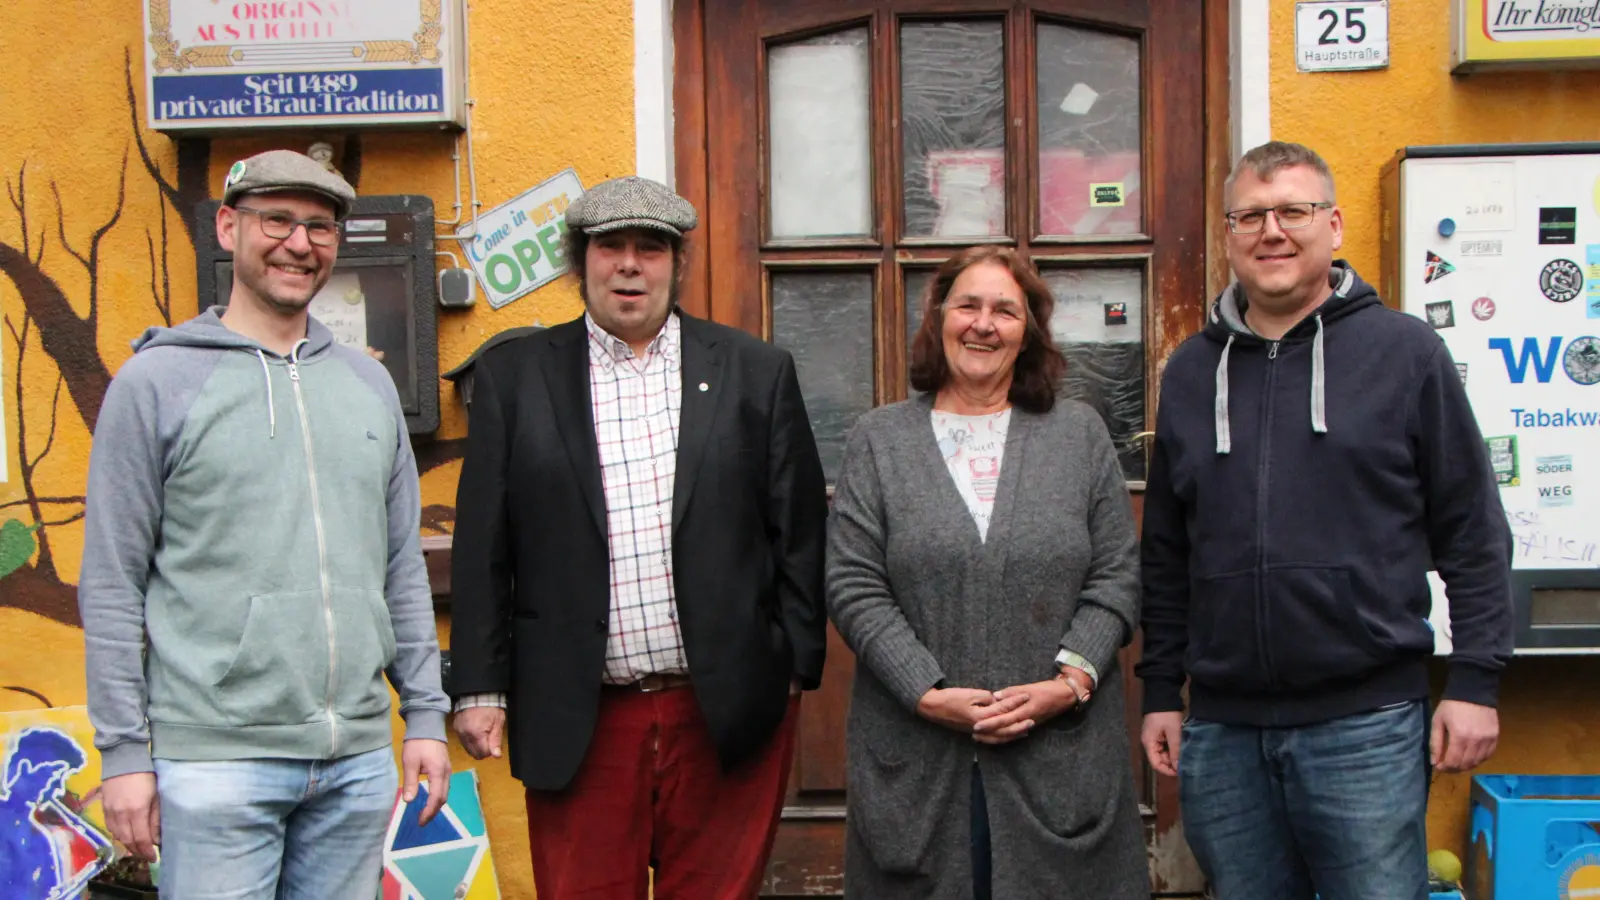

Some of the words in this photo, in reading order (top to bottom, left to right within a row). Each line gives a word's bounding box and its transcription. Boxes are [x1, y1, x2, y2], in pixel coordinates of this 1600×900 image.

[1318, 8, 1366, 45] 25
[1494, 1, 1532, 25] Ihr
[1535, 0, 1600, 32] königl
[1305, 48, 1380, 62] Hauptstraße
[244, 74, 293, 95] Seit
[299, 73, 358, 94] 1489
[159, 97, 251, 120] private
[254, 90, 438, 115] Brau-Tradition
[471, 224, 510, 262] Come
[510, 209, 528, 227] in
[485, 219, 568, 294] OPE
[1510, 408, 1600, 428] Tabakw
[1536, 464, 1572, 475] SÖDER
[1538, 486, 1572, 497] WEG
